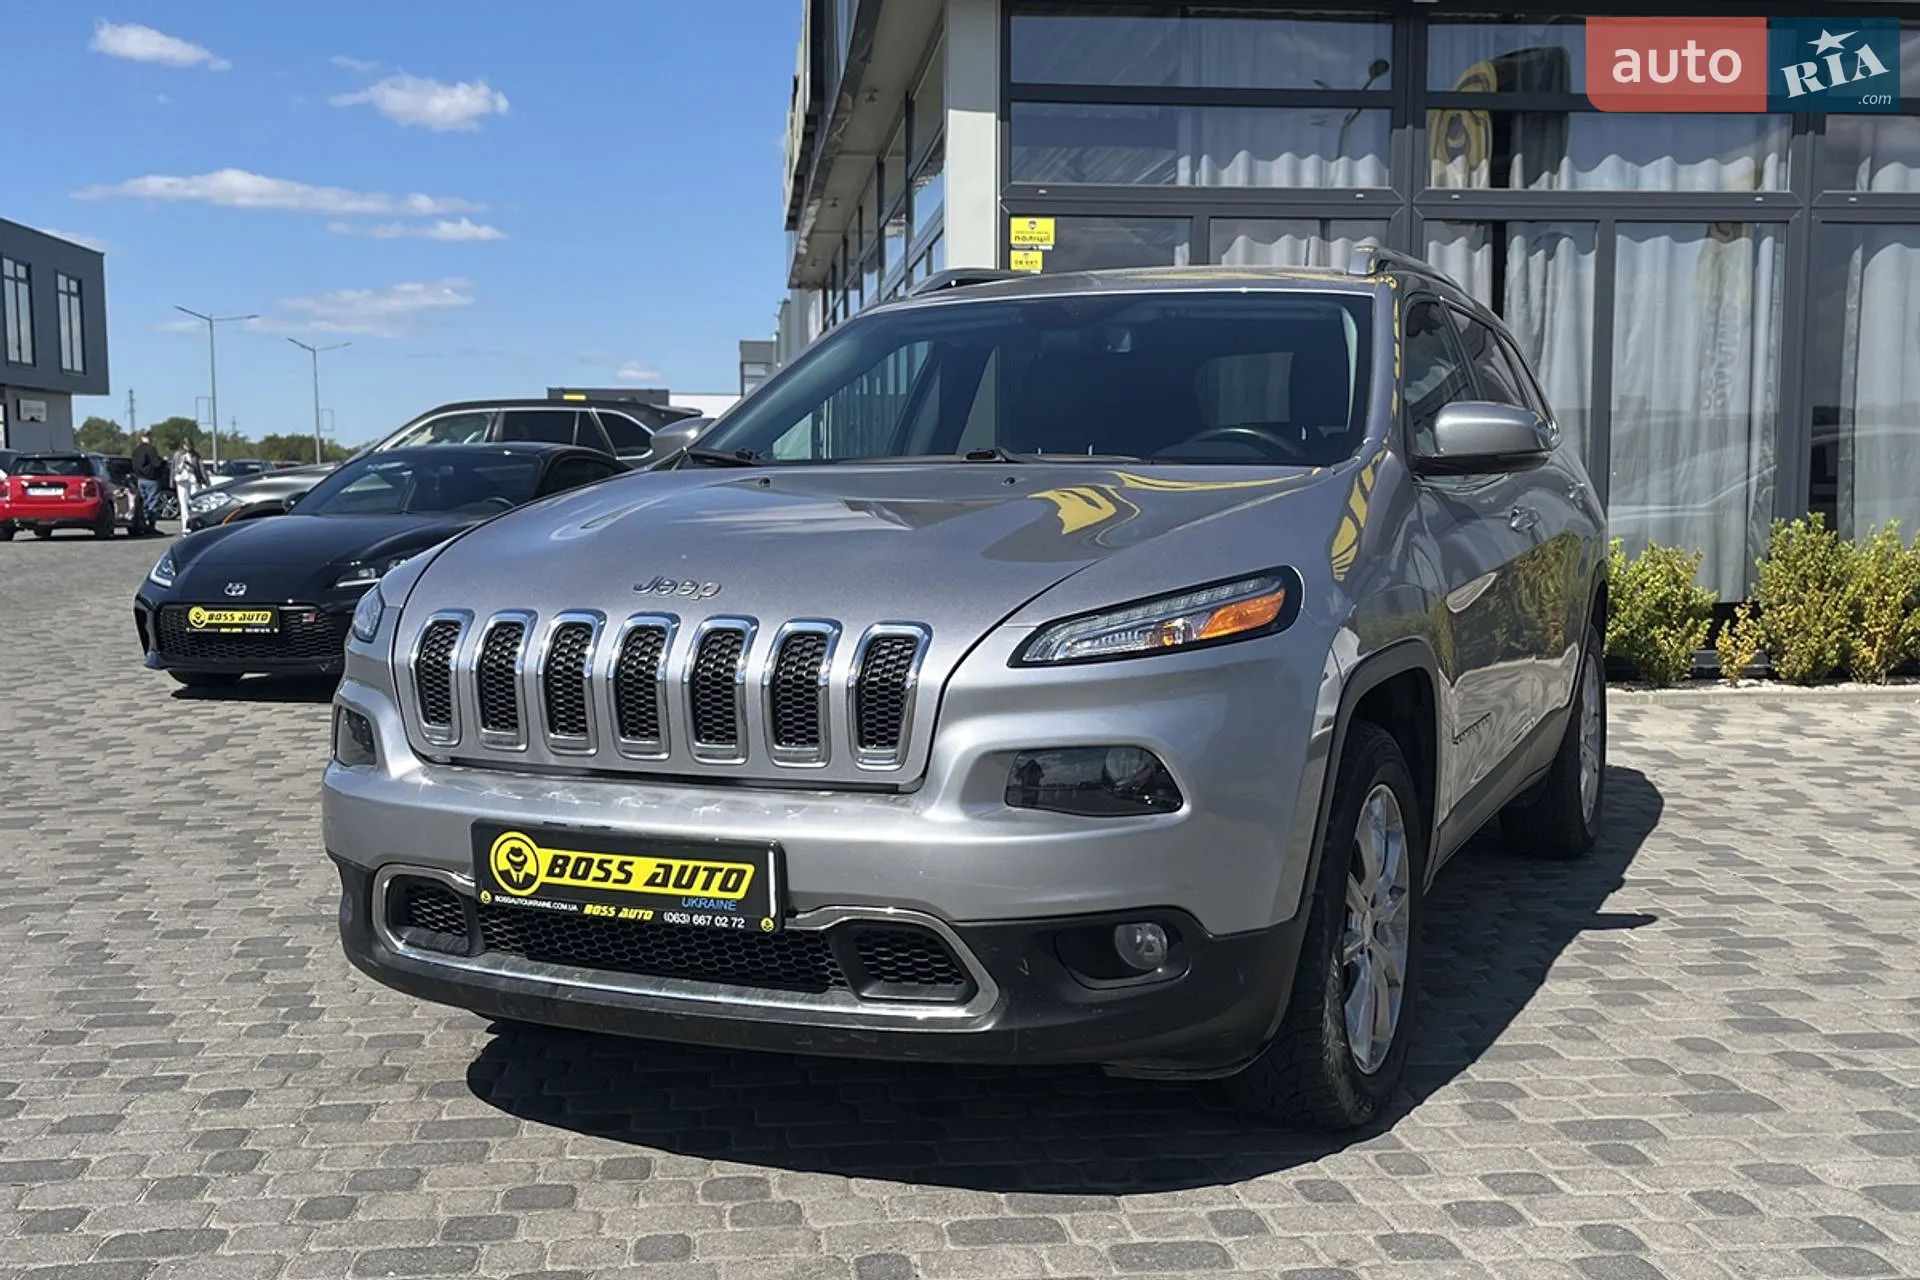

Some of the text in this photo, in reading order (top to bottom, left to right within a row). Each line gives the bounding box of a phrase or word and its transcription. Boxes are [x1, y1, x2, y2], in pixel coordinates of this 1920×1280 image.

[632, 575, 722, 601] Jeep
[207, 613, 269, 621] BOSS AUTO
[545, 854, 748, 893] BOSS AUTO
[583, 903, 654, 920] BOSS AUTO
[681, 896, 737, 911] UKRAINE
[663, 911, 746, 929] (063) 667 02 72
